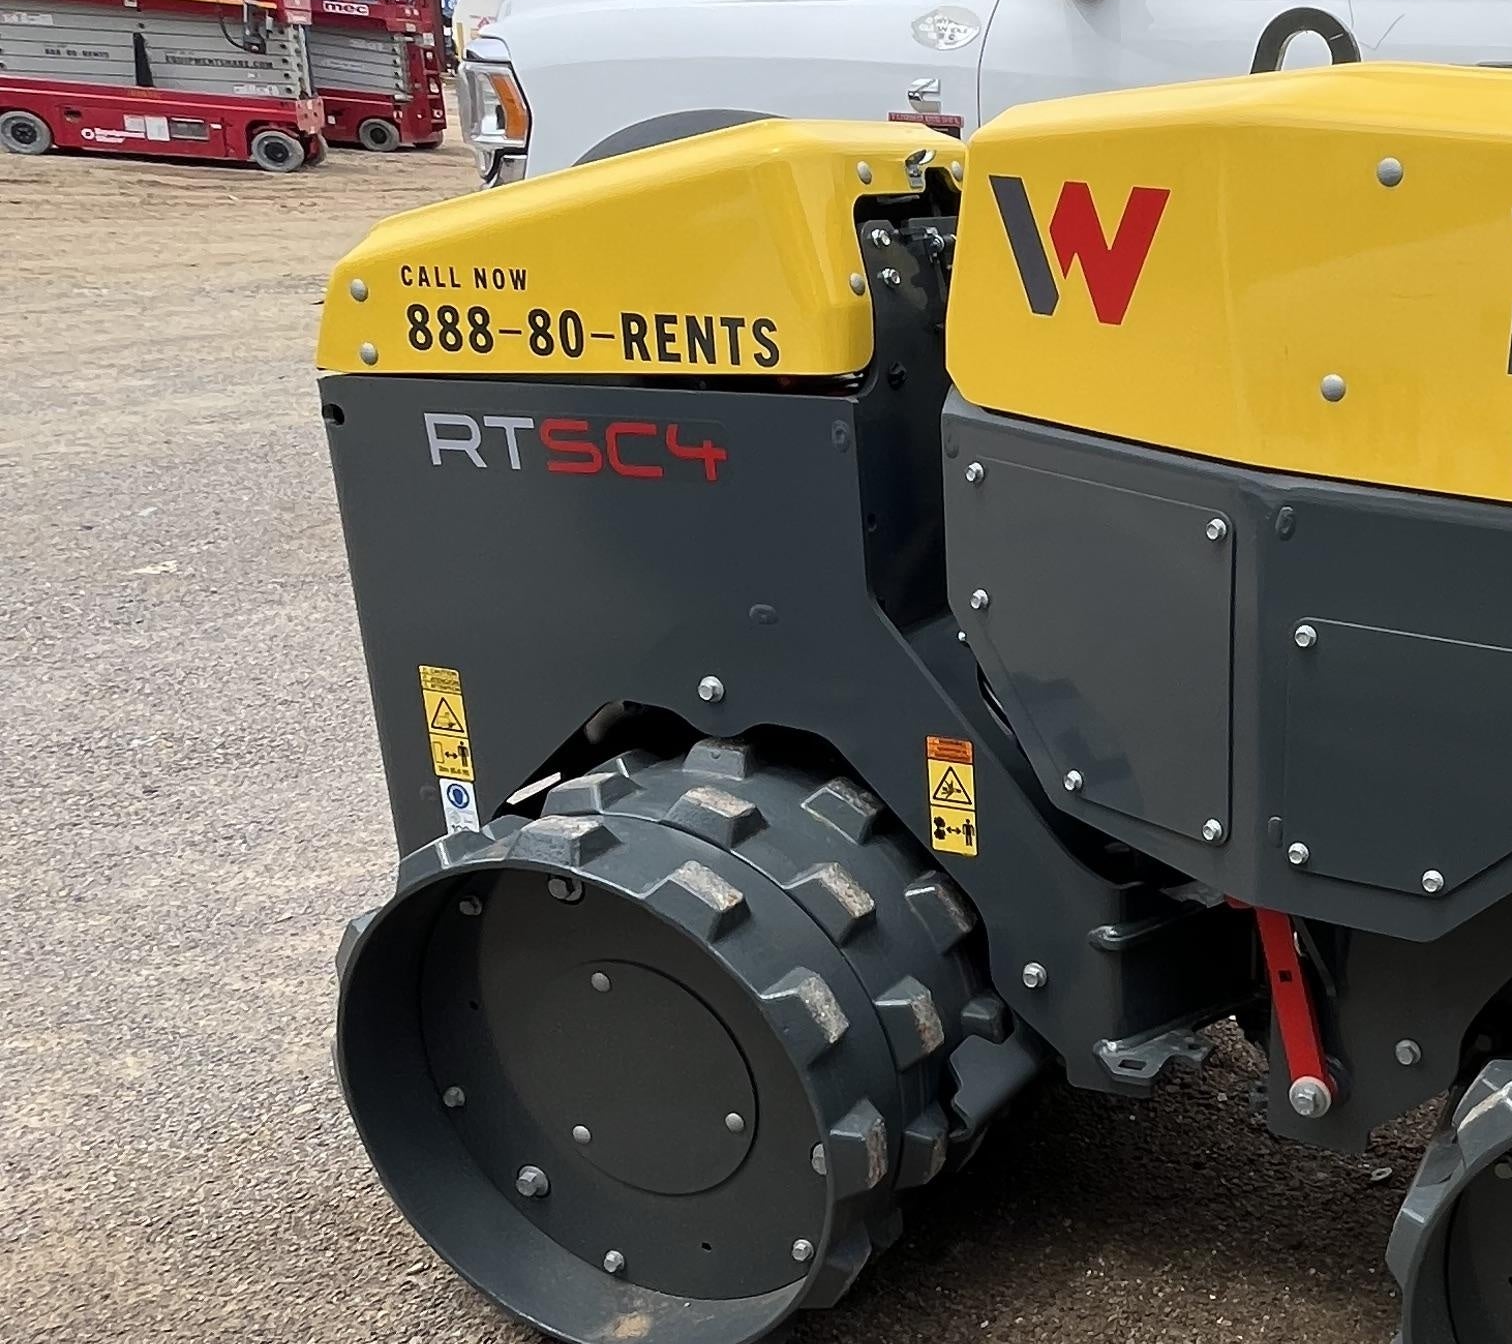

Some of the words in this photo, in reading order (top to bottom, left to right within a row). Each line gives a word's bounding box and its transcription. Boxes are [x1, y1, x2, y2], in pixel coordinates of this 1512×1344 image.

[325, 2, 368, 14] mec
[400, 264, 462, 289] CALL
[473, 267, 528, 291] NOW
[405, 303, 781, 368] 888-80-RENTS
